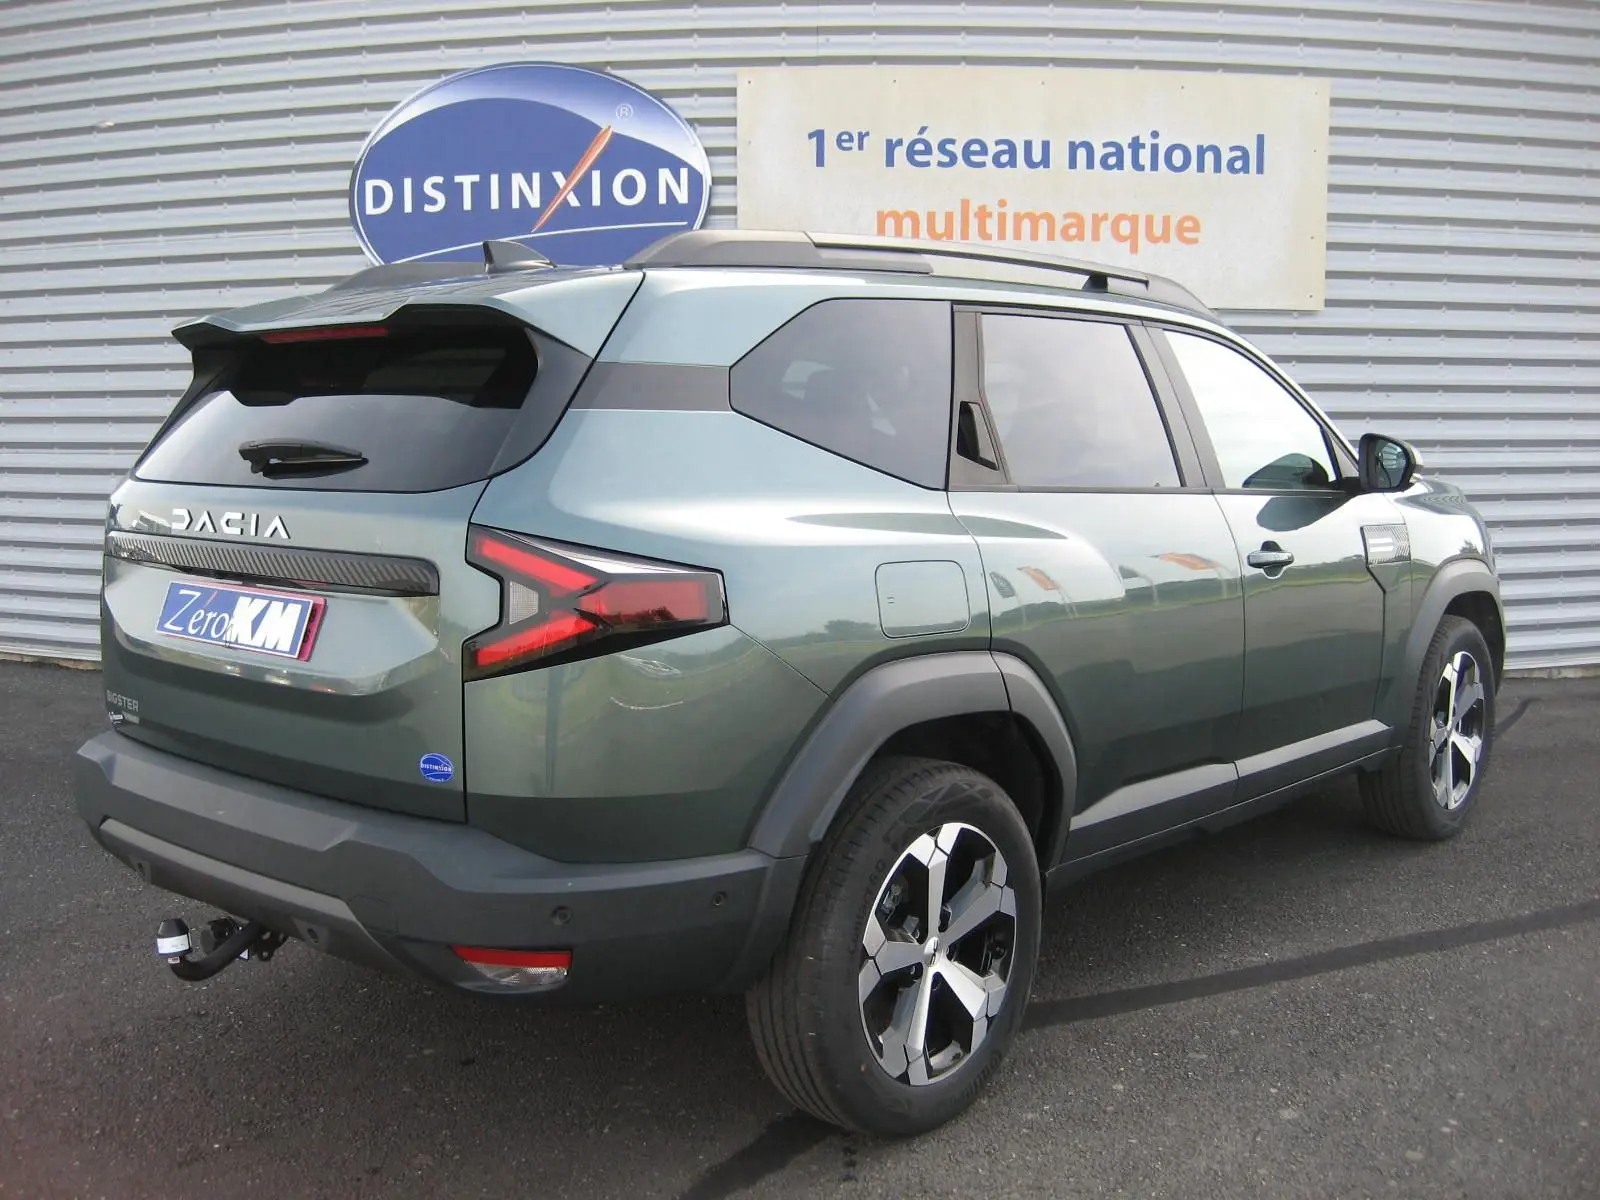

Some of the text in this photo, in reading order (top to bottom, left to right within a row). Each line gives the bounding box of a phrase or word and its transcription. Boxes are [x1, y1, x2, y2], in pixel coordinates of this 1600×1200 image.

[885, 128, 1051, 170] réseau
[1067, 133, 1266, 175] national
[363, 158, 691, 222] DISTINXION
[876, 197, 1203, 255] multimarque
[171, 508, 291, 540] DACIA
